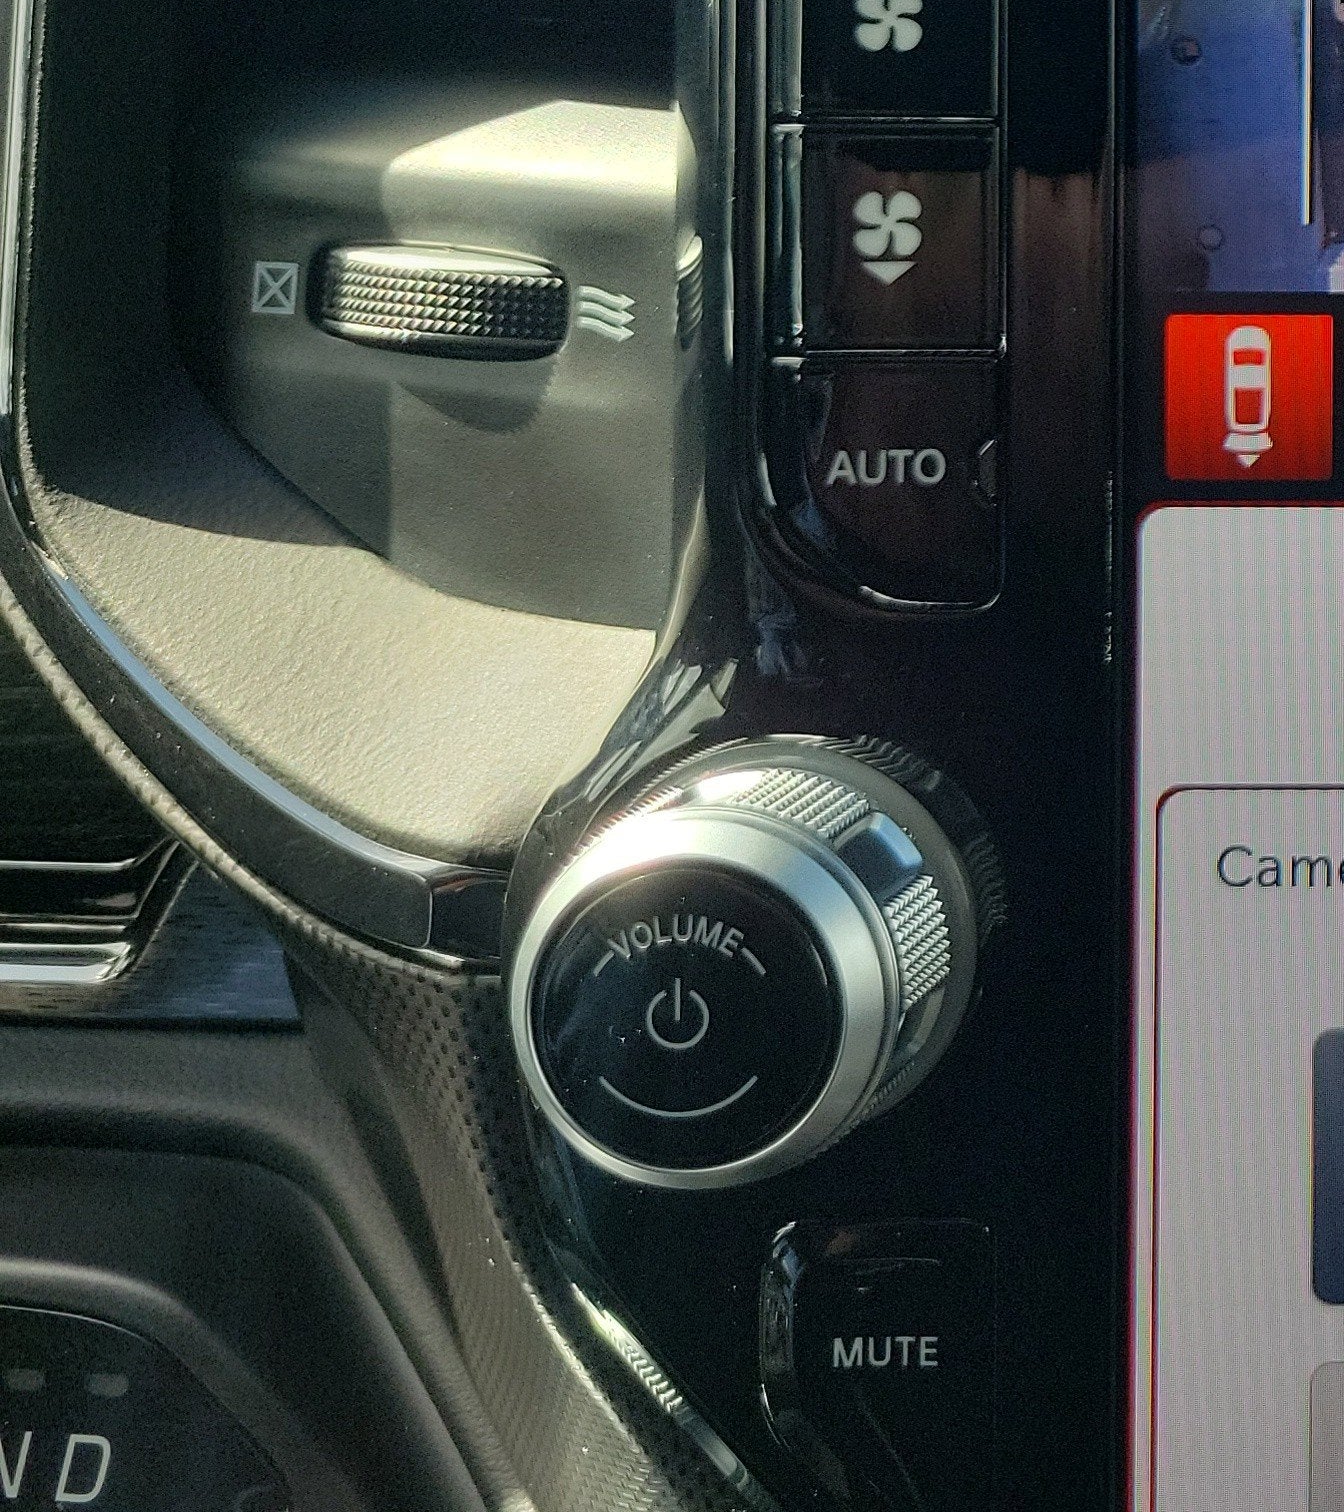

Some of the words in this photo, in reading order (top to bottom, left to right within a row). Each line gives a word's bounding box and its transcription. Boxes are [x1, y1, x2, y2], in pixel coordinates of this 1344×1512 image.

[826, 448, 946, 486] AUTO
[608, 913, 745, 959] VOLUME
[832, 1335, 938, 1368] MUTE
[54, 1433, 111, 1502] D
